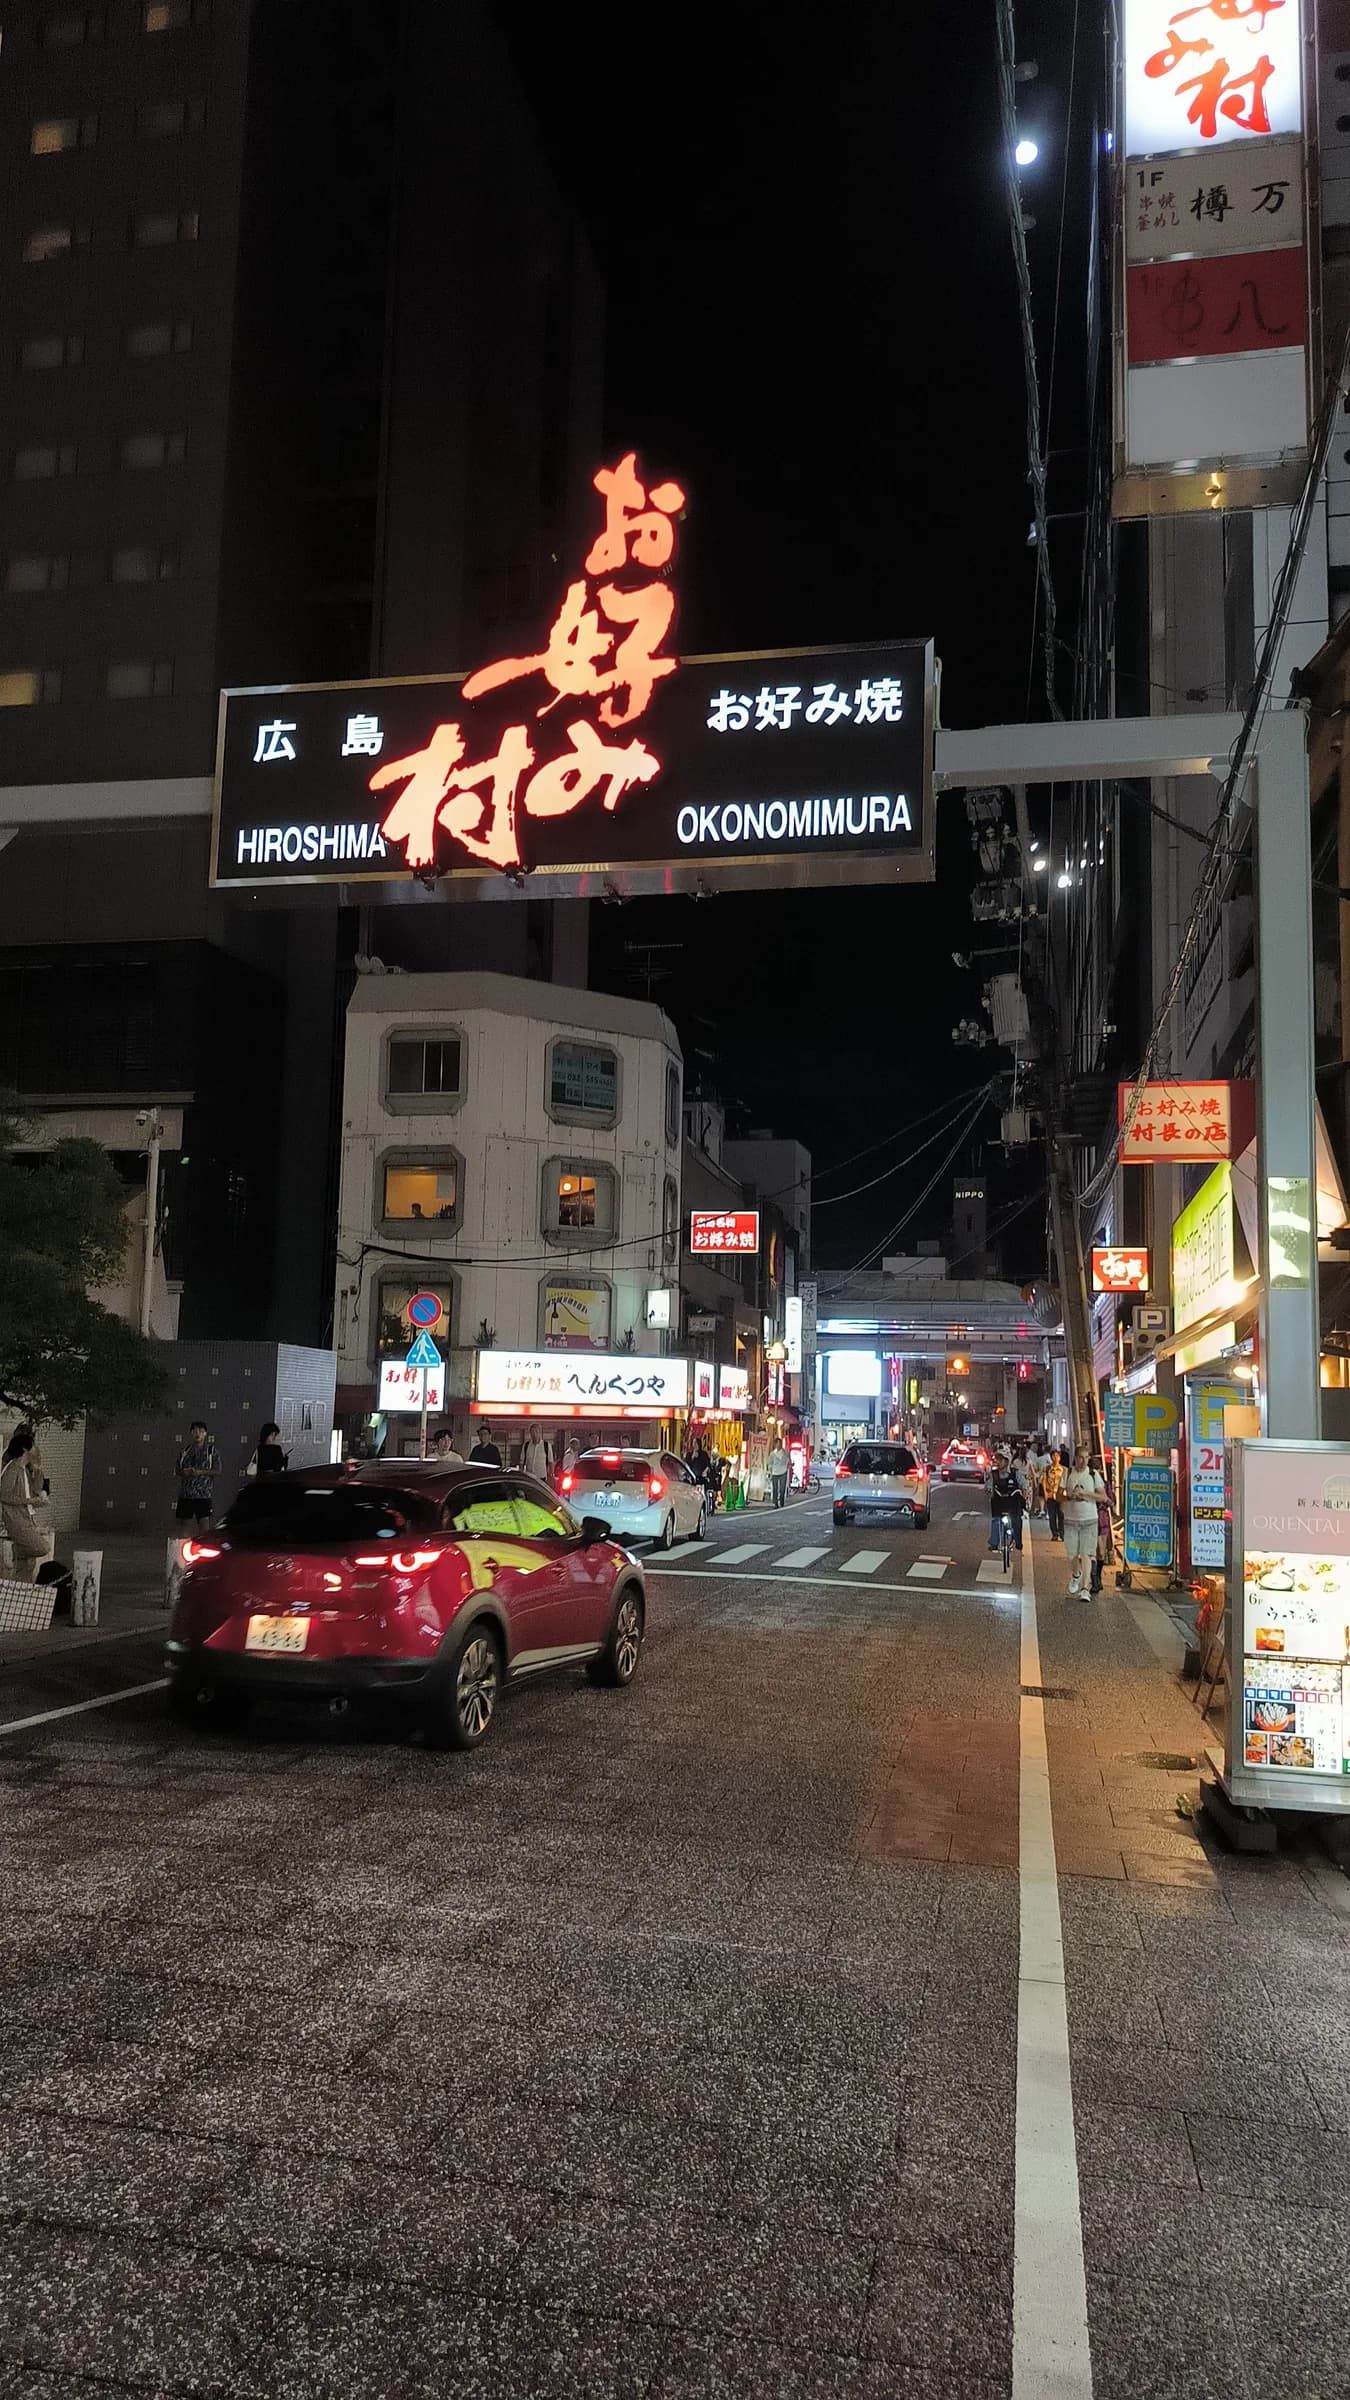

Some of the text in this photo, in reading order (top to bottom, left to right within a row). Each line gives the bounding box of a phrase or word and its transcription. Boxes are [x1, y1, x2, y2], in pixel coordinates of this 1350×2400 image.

[1137, 171, 1164, 187] 1F
[706, 677, 903, 732] お好み焼
[677, 795, 912, 843] OKONOMIMURA
[237, 822, 387, 864] HIROSHIMA
[1137, 1098, 1221, 1117] お好み焼
[1130, 1121, 1227, 1142] 村長の店
[955, 1191, 984, 1199] NIPPO
[695, 1231, 754, 1247] お好み焼
[1141, 1310, 1163, 1329] P
[567, 1373, 665, 1396] へんくつや
[1109, 1396, 1134, 1445] 空車
[1135, 1394, 1177, 1447] P
[1253, 1515, 1345, 1536] ORIENTAL
